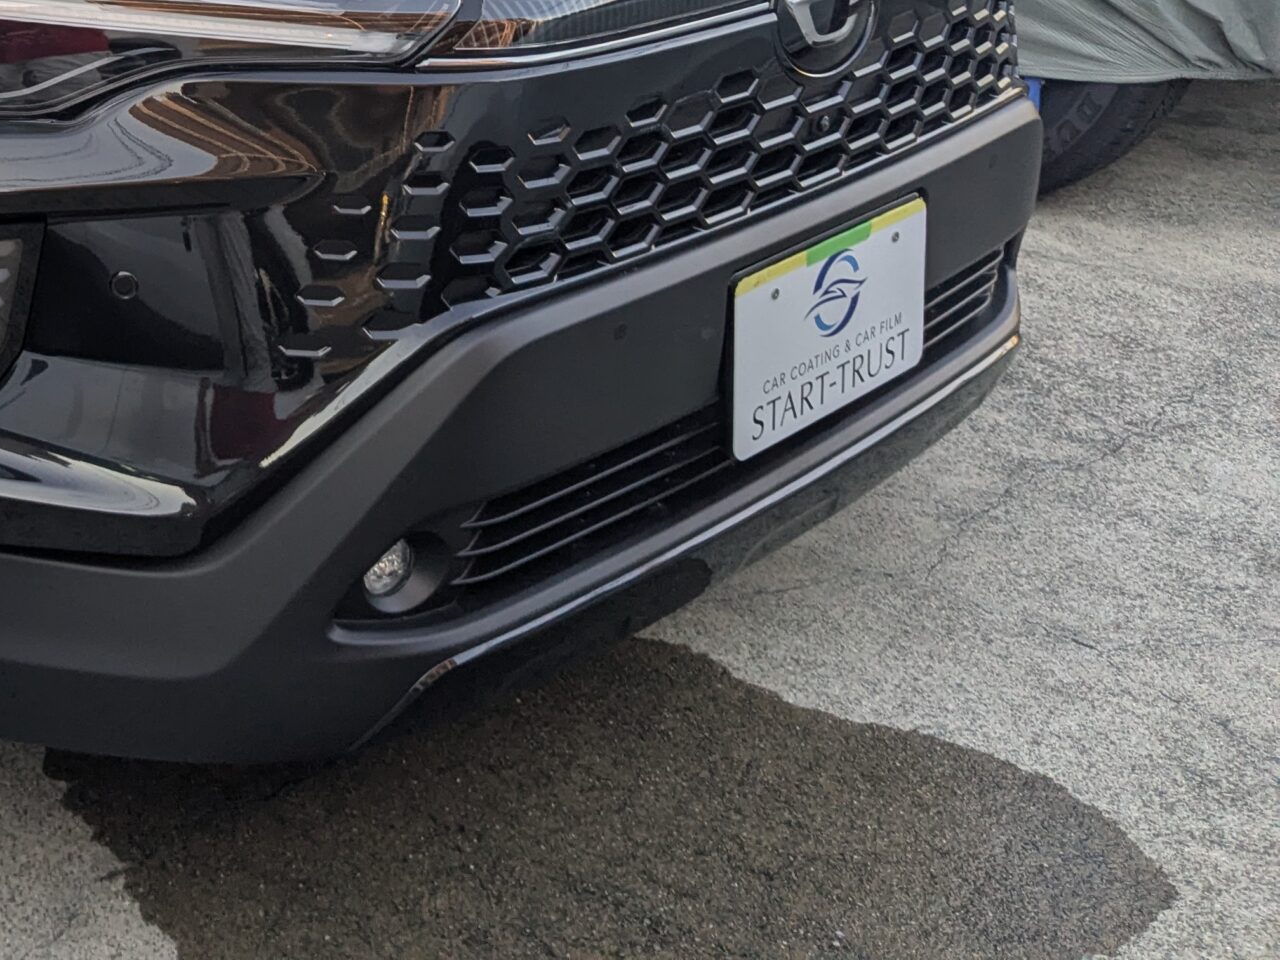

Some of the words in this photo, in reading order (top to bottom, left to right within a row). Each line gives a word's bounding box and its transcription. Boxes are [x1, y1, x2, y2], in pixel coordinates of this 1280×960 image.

[751, 328, 910, 441] START-TRUST
[762, 372, 786, 395] CAR
[790, 344, 840, 381] COATING
[843, 338, 852, 353] &
[855, 326, 876, 348] CAR
[879, 311, 903, 333] FILM
